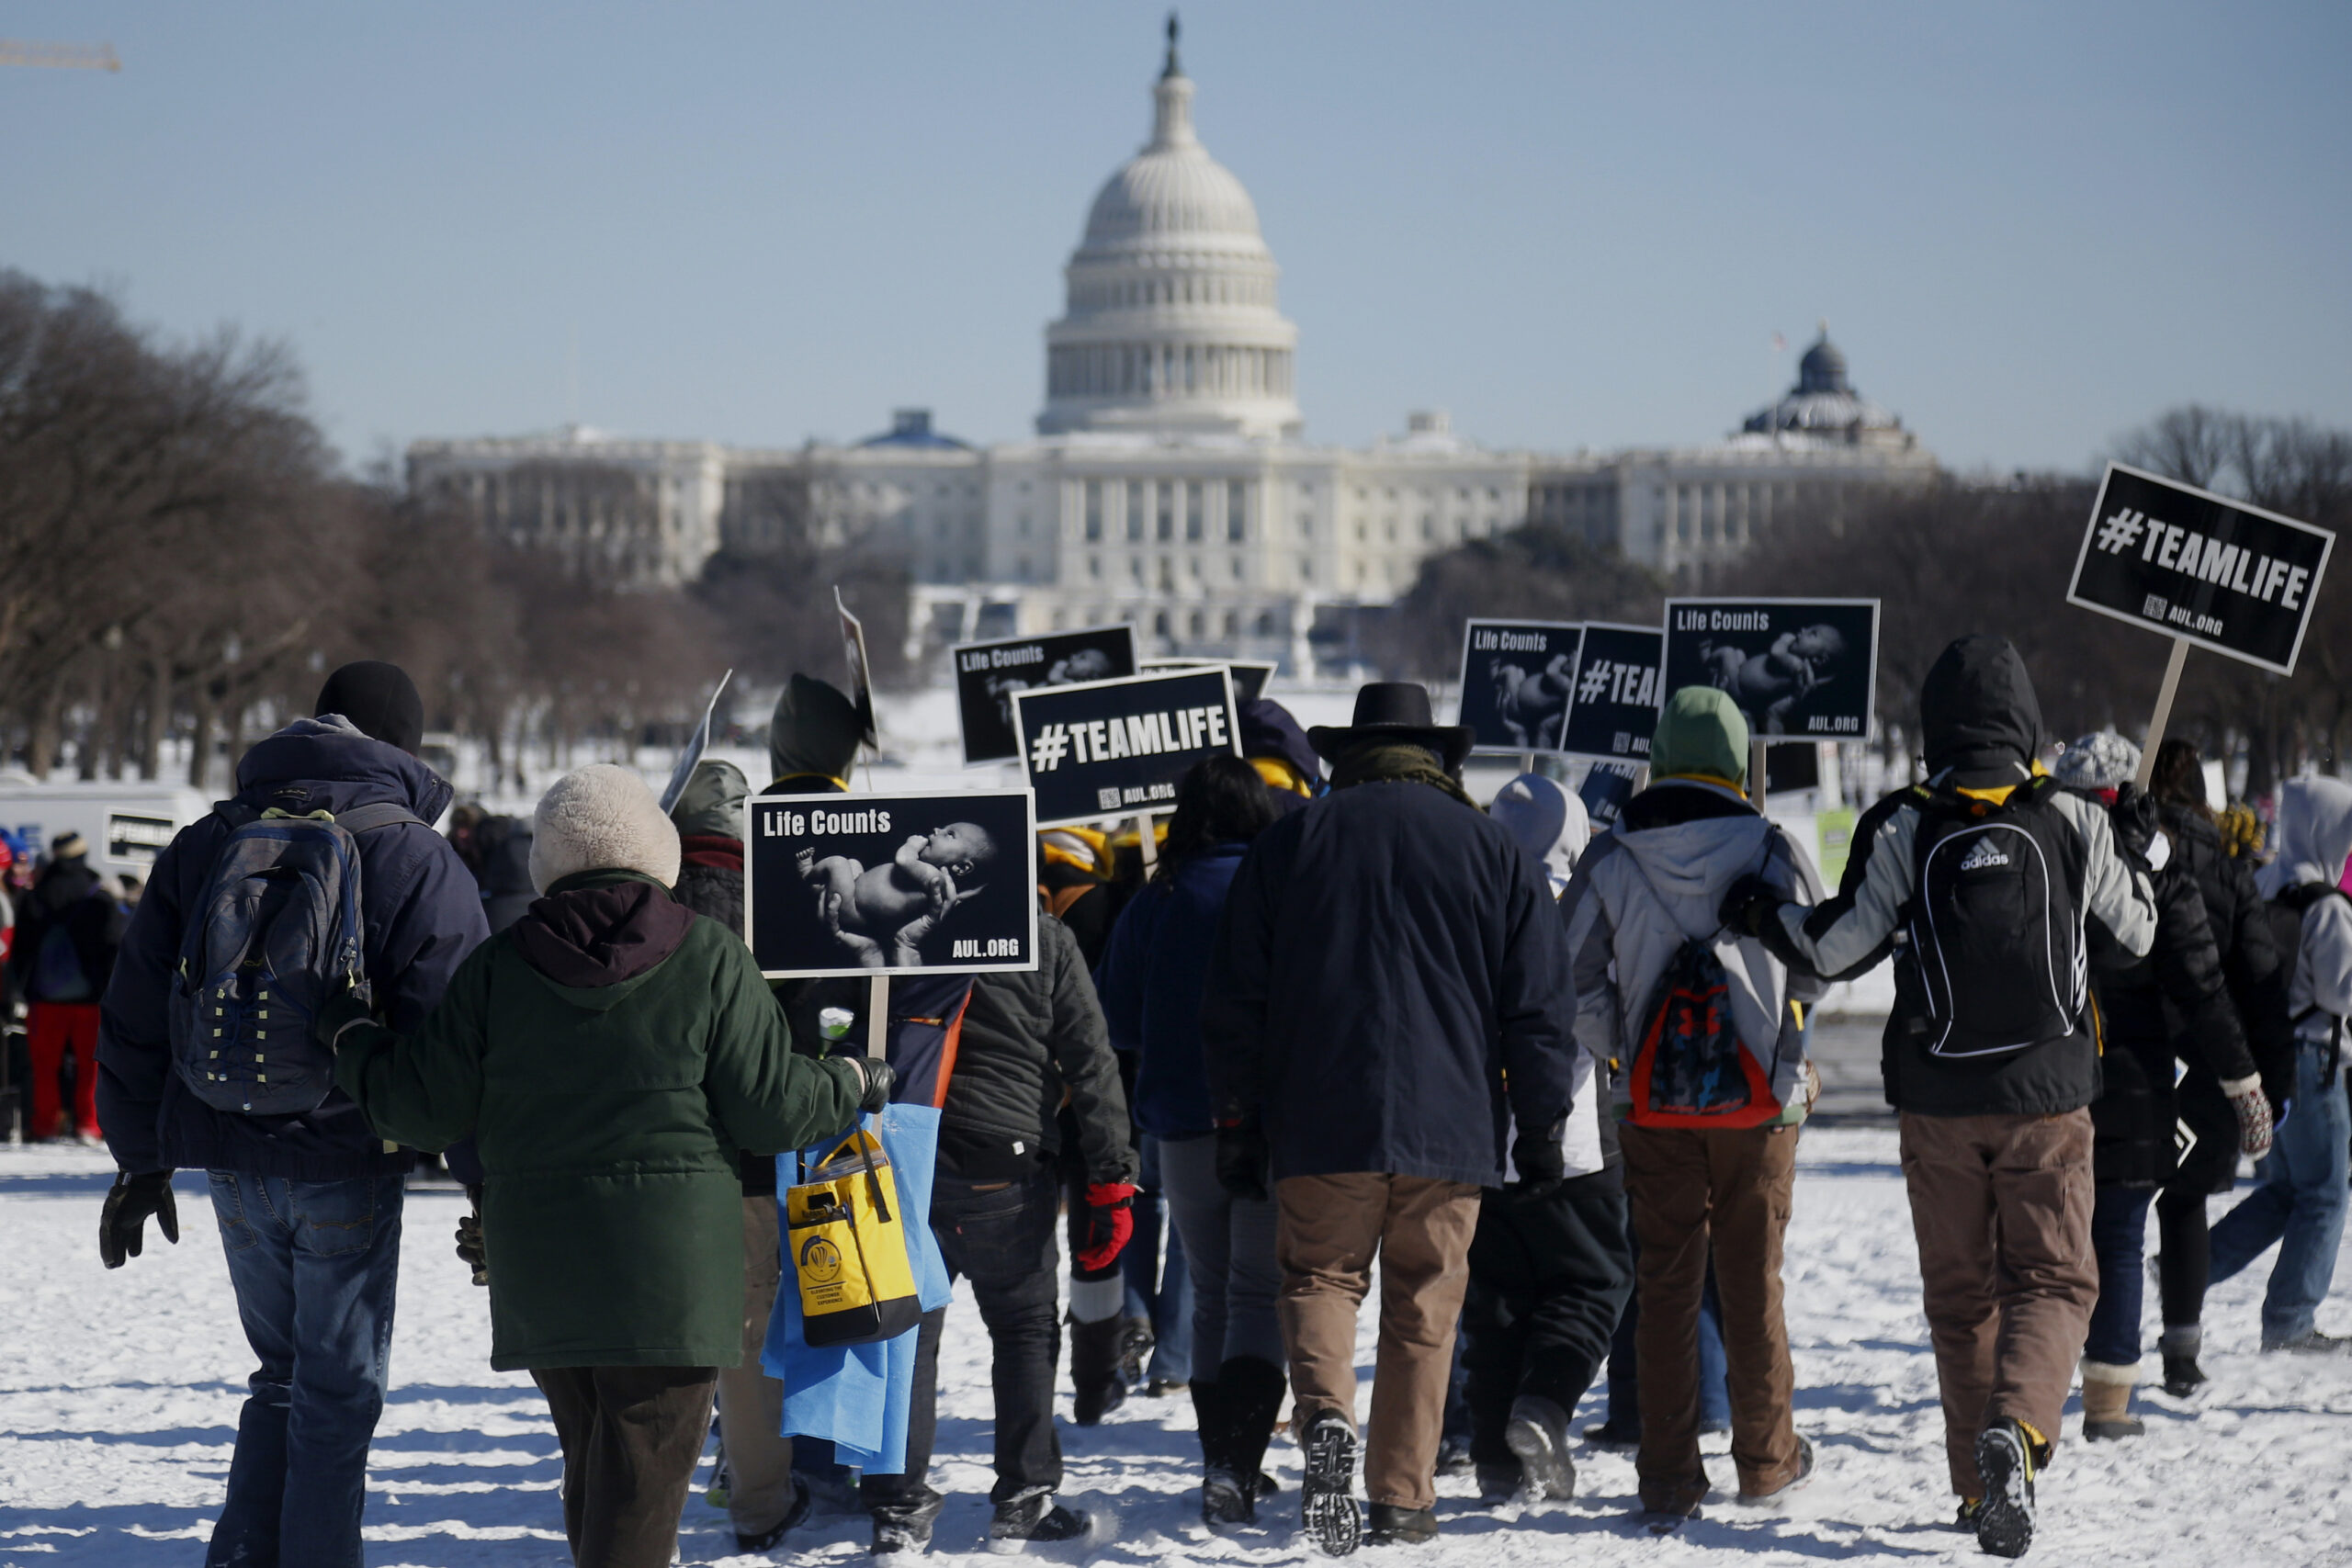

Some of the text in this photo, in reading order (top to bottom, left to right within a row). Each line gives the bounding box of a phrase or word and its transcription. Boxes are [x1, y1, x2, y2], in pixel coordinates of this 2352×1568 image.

[2098, 507, 2309, 611] #TEAMLIFE
[1678, 610, 1770, 631] Life Counts
[2167, 605, 2223, 637] AUL.ORG
[1475, 630, 1547, 652] Life Counts
[961, 646, 1045, 672] Life Counts
[1808, 716, 1859, 731] AUL.ORG
[1031, 705, 1228, 773] #TEAMLIFE
[1123, 784, 1176, 804] AUL.ORG
[763, 808, 891, 837] Life Counts
[1961, 853, 2009, 871] adidas
[952, 938, 1019, 958] AUL.ORG
[818, 1297, 843, 1305] EXPERIENCE
